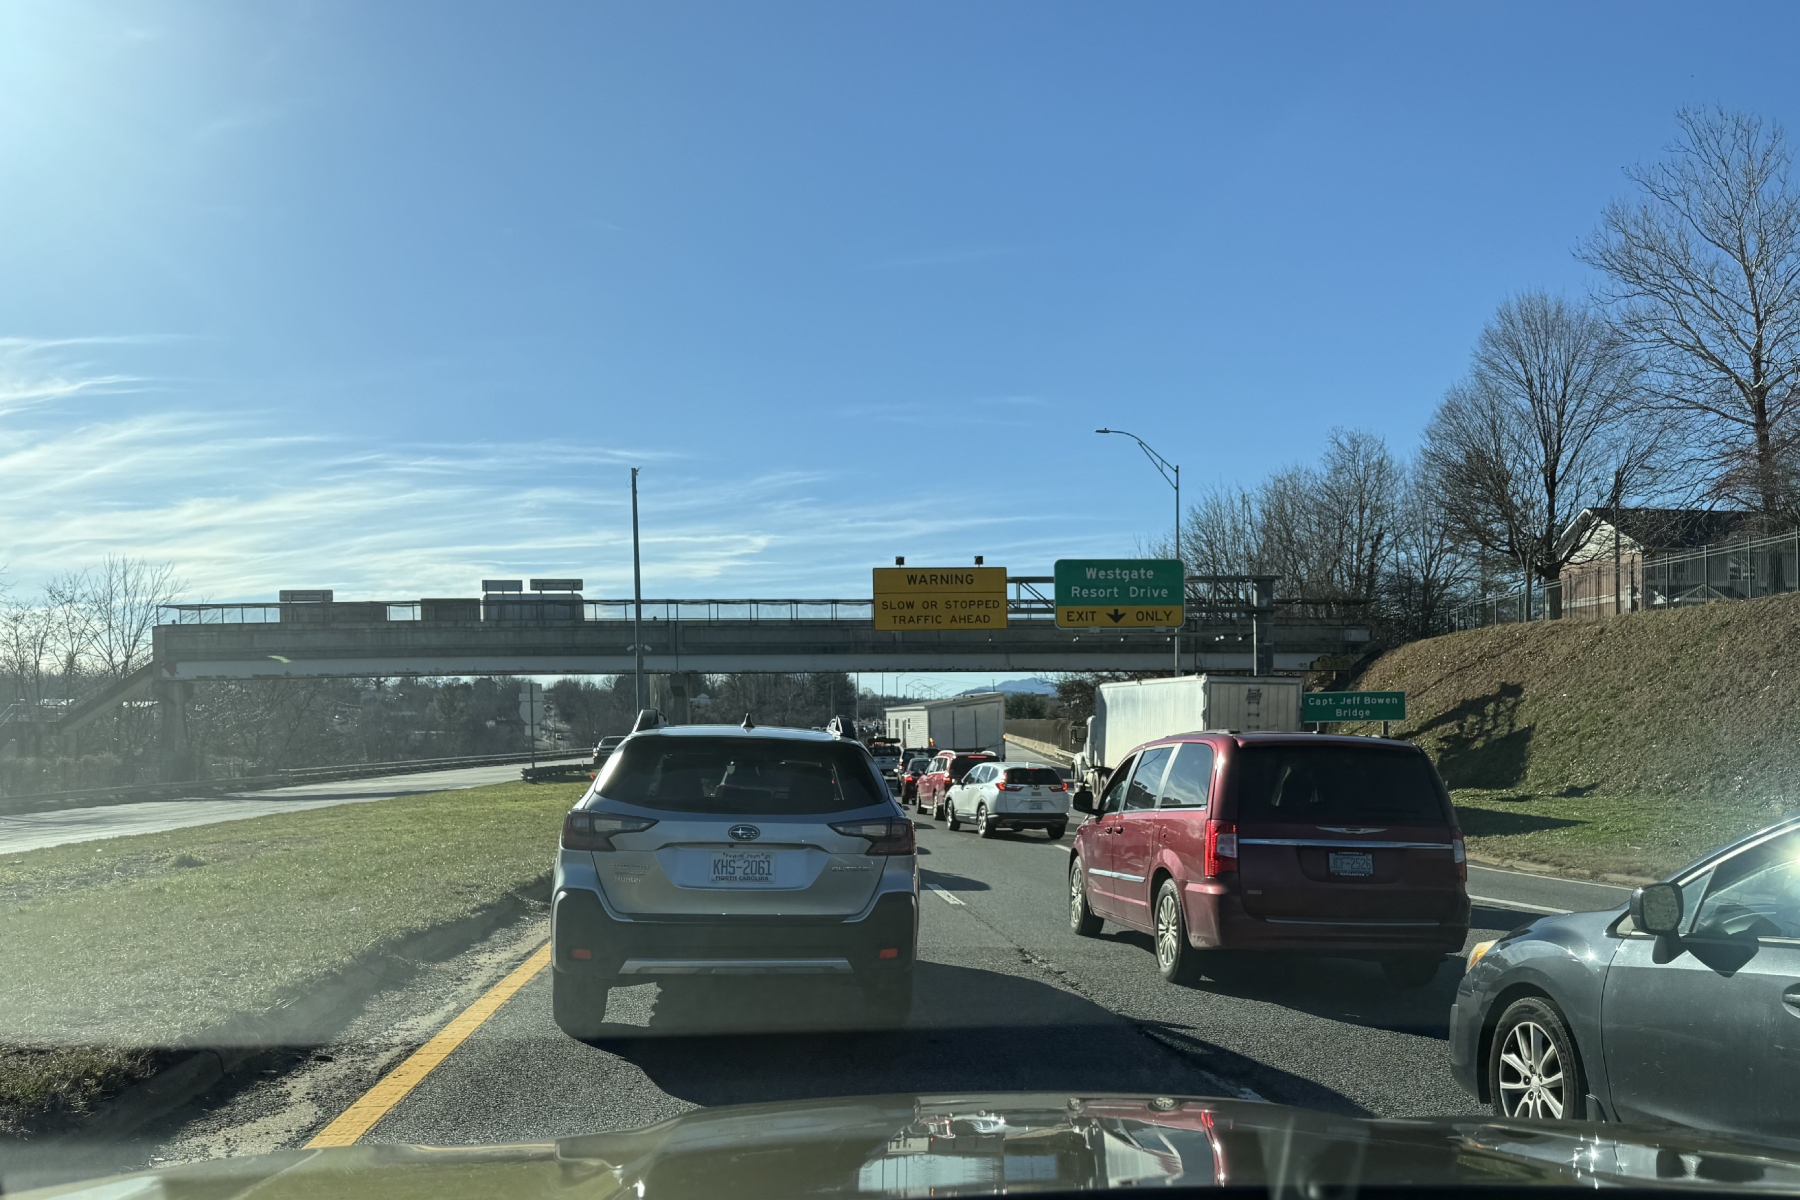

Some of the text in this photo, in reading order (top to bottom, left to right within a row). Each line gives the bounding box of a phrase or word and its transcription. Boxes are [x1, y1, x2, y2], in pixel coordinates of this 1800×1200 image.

[907, 574, 974, 585] WARNING
[1086, 567, 1154, 582] Westgate
[1071, 586, 1168, 598] Resort Drive
[882, 600, 1000, 610] SLOW OR STOPPED
[892, 614, 991, 625] TRAFFIC AHEAD
[1066, 610, 1173, 622] EXIT ONLY
[1308, 696, 1398, 706] Capt. Jeff Bowen
[1336, 708, 1371, 718] Bridge
[713, 859, 772, 876] KHS-2061
[614, 876, 641, 884] Hunter
